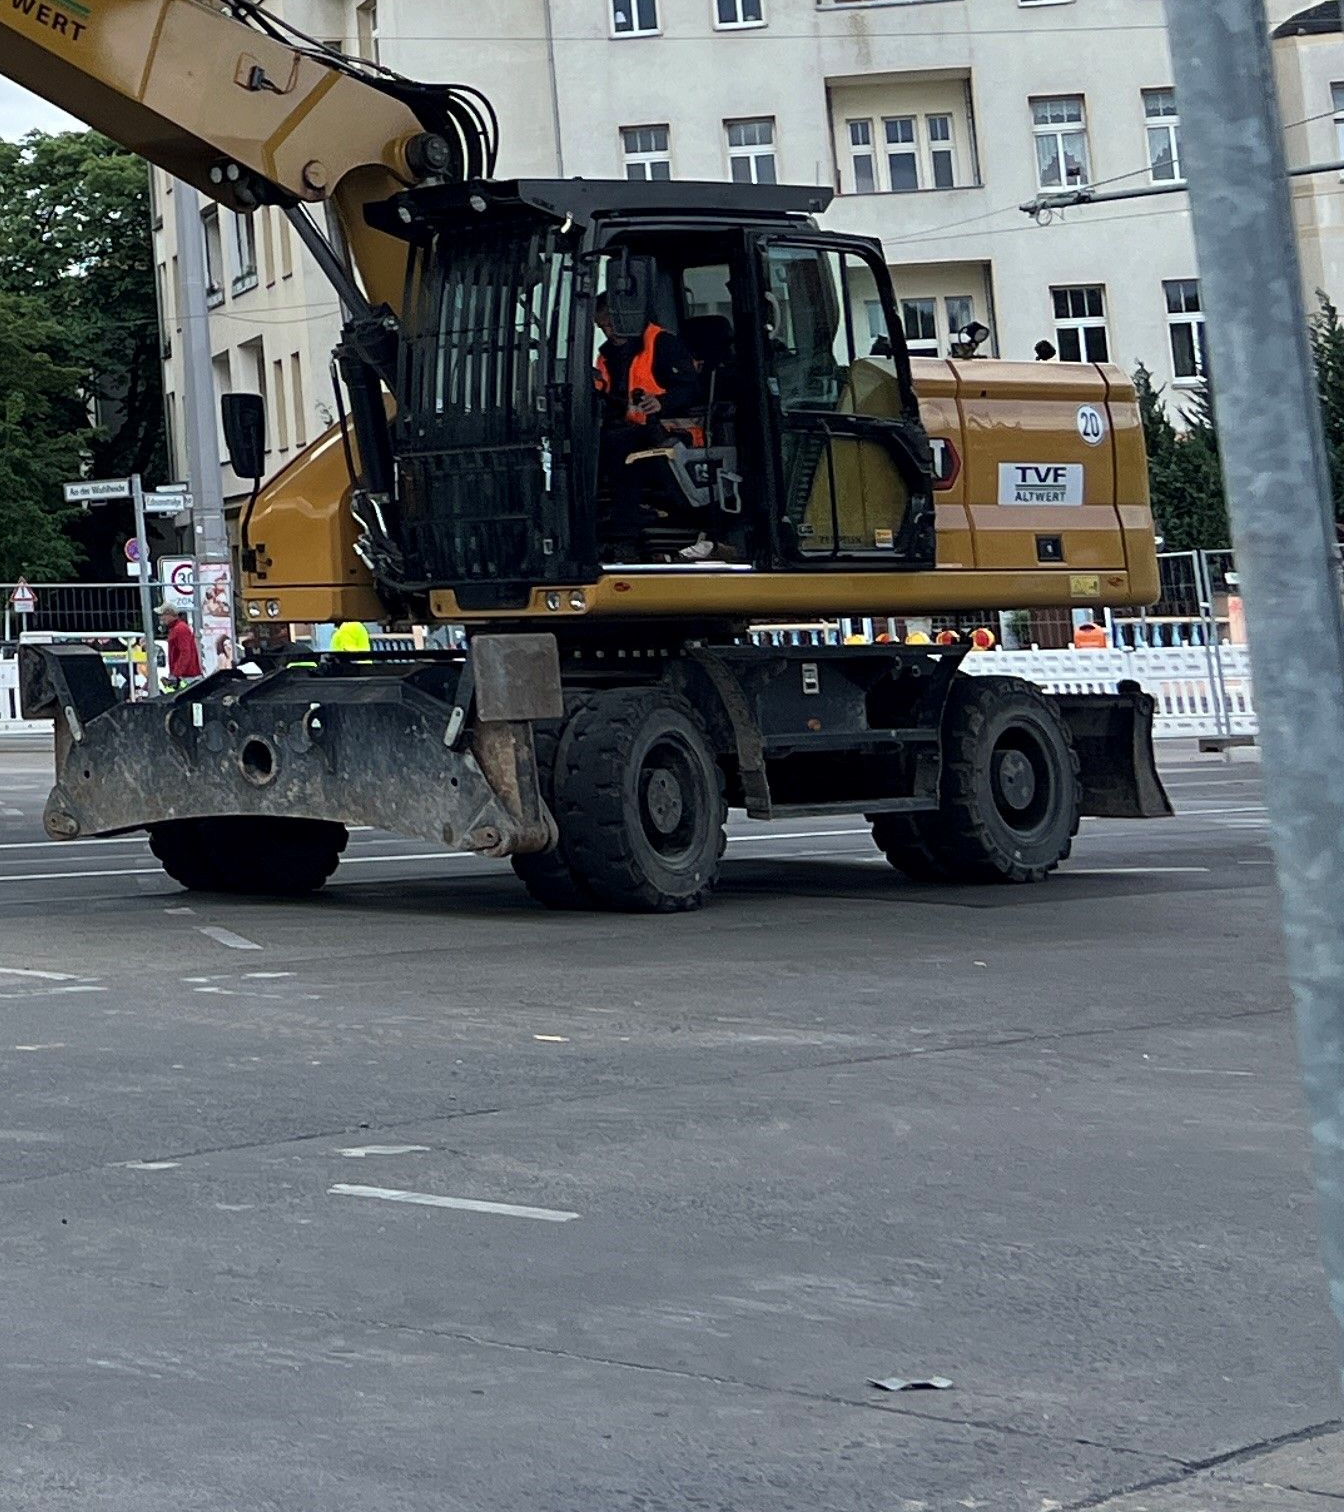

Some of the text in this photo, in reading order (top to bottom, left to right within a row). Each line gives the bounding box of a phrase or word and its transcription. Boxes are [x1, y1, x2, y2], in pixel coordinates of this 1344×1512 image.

[1081, 412, 1100, 437] 20
[1015, 467, 1067, 483] TVF
[1015, 491, 1066, 502] ALTWERT
